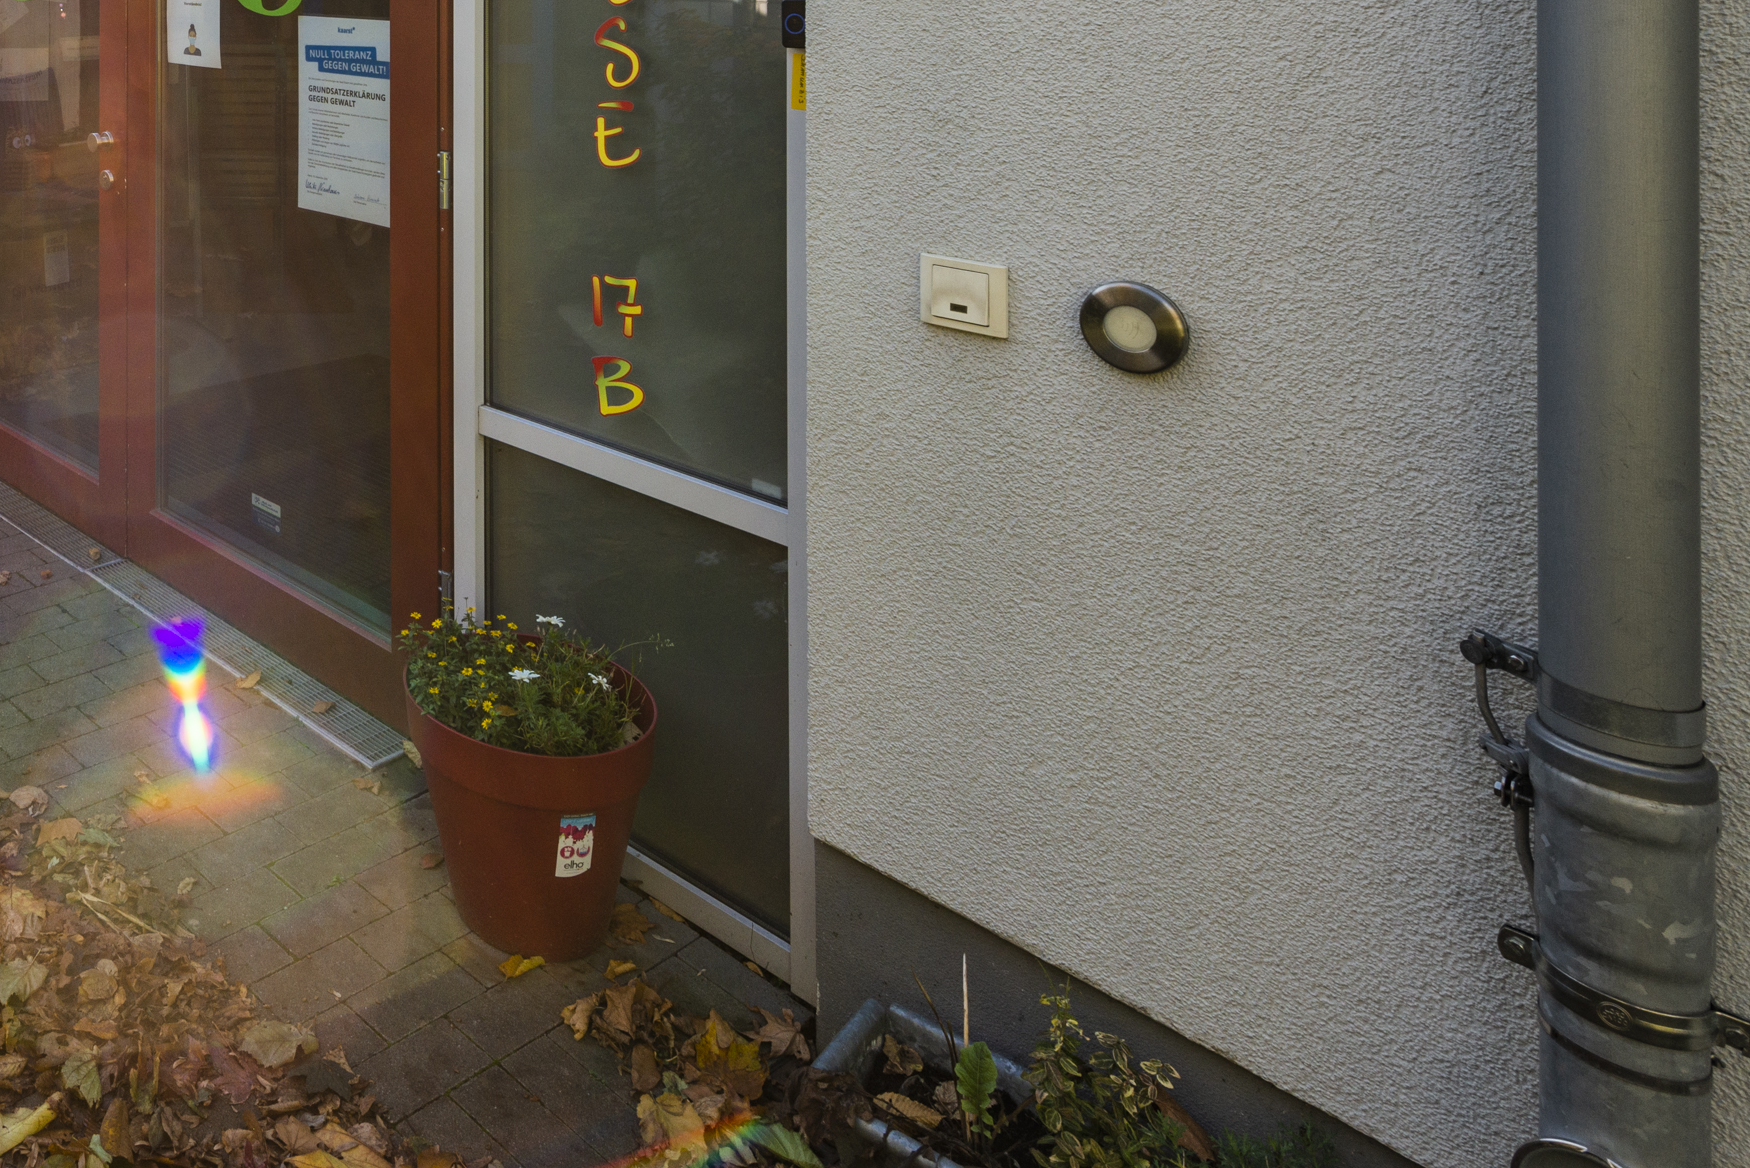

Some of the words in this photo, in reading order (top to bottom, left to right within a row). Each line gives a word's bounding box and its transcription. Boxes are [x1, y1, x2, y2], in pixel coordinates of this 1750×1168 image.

[309, 49, 329, 59] NULL
[330, 50, 372, 60] TOLERANZ
[322, 60, 349, 71] GEGEN
[350, 63, 386, 75] GEWALT!
[308, 84, 386, 101] GRUNDSATZERKLÄRUNG
[308, 94, 329, 104] GEGEN
[330, 97, 356, 108] GEWALT
[591, 274, 643, 338] 17
[591, 356, 645, 417] B
[564, 860, 584, 870] elho
